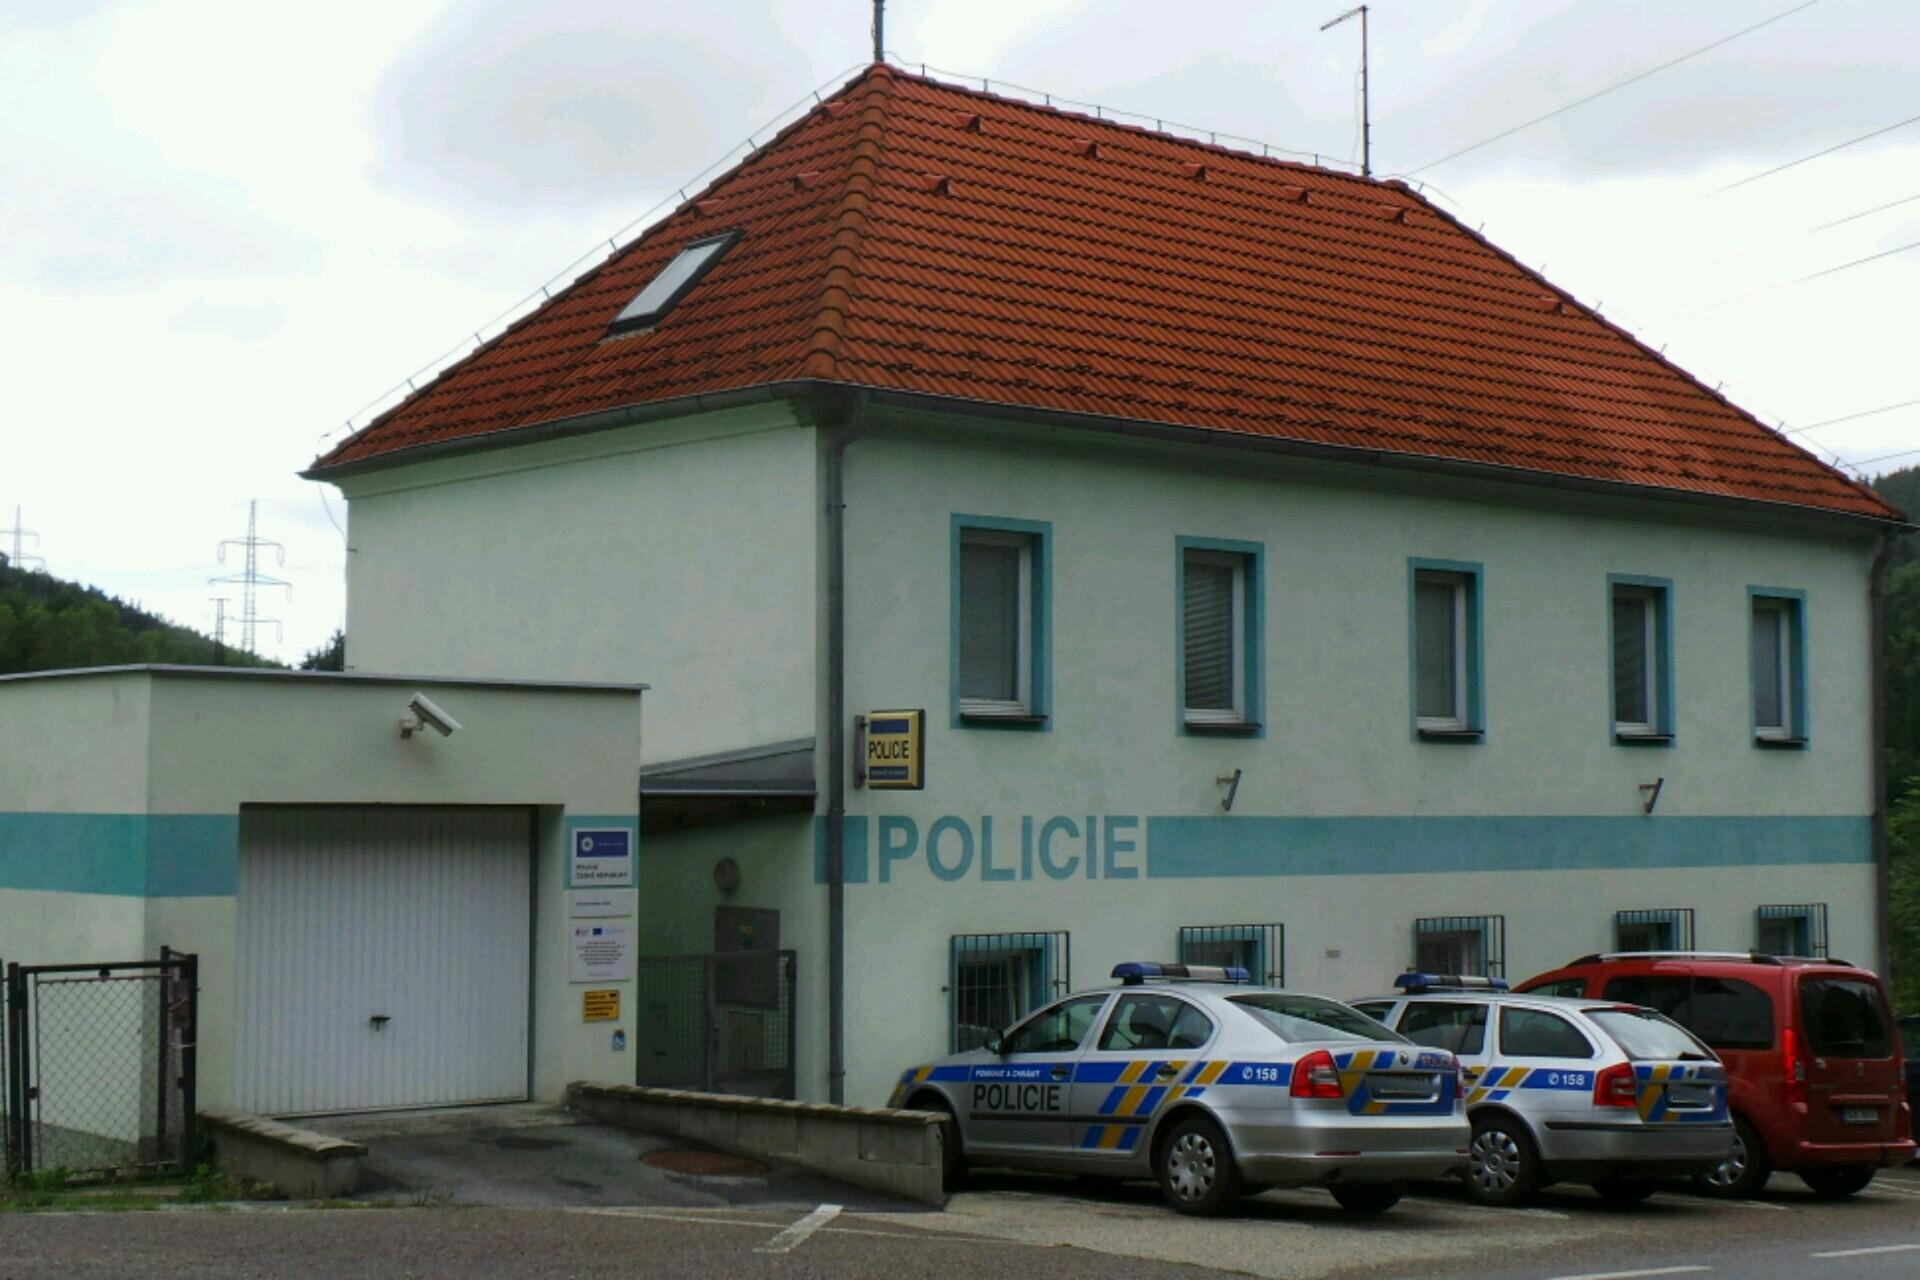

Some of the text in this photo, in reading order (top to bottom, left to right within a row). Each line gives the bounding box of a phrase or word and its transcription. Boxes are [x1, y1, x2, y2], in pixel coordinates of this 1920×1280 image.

[869, 740, 909, 759] POLICIE
[878, 816, 1139, 883] POLICIE
[1255, 1067, 1278, 1081] 158
[1562, 1073, 1585, 1086] 158
[973, 1083, 1061, 1111] POLICIE
